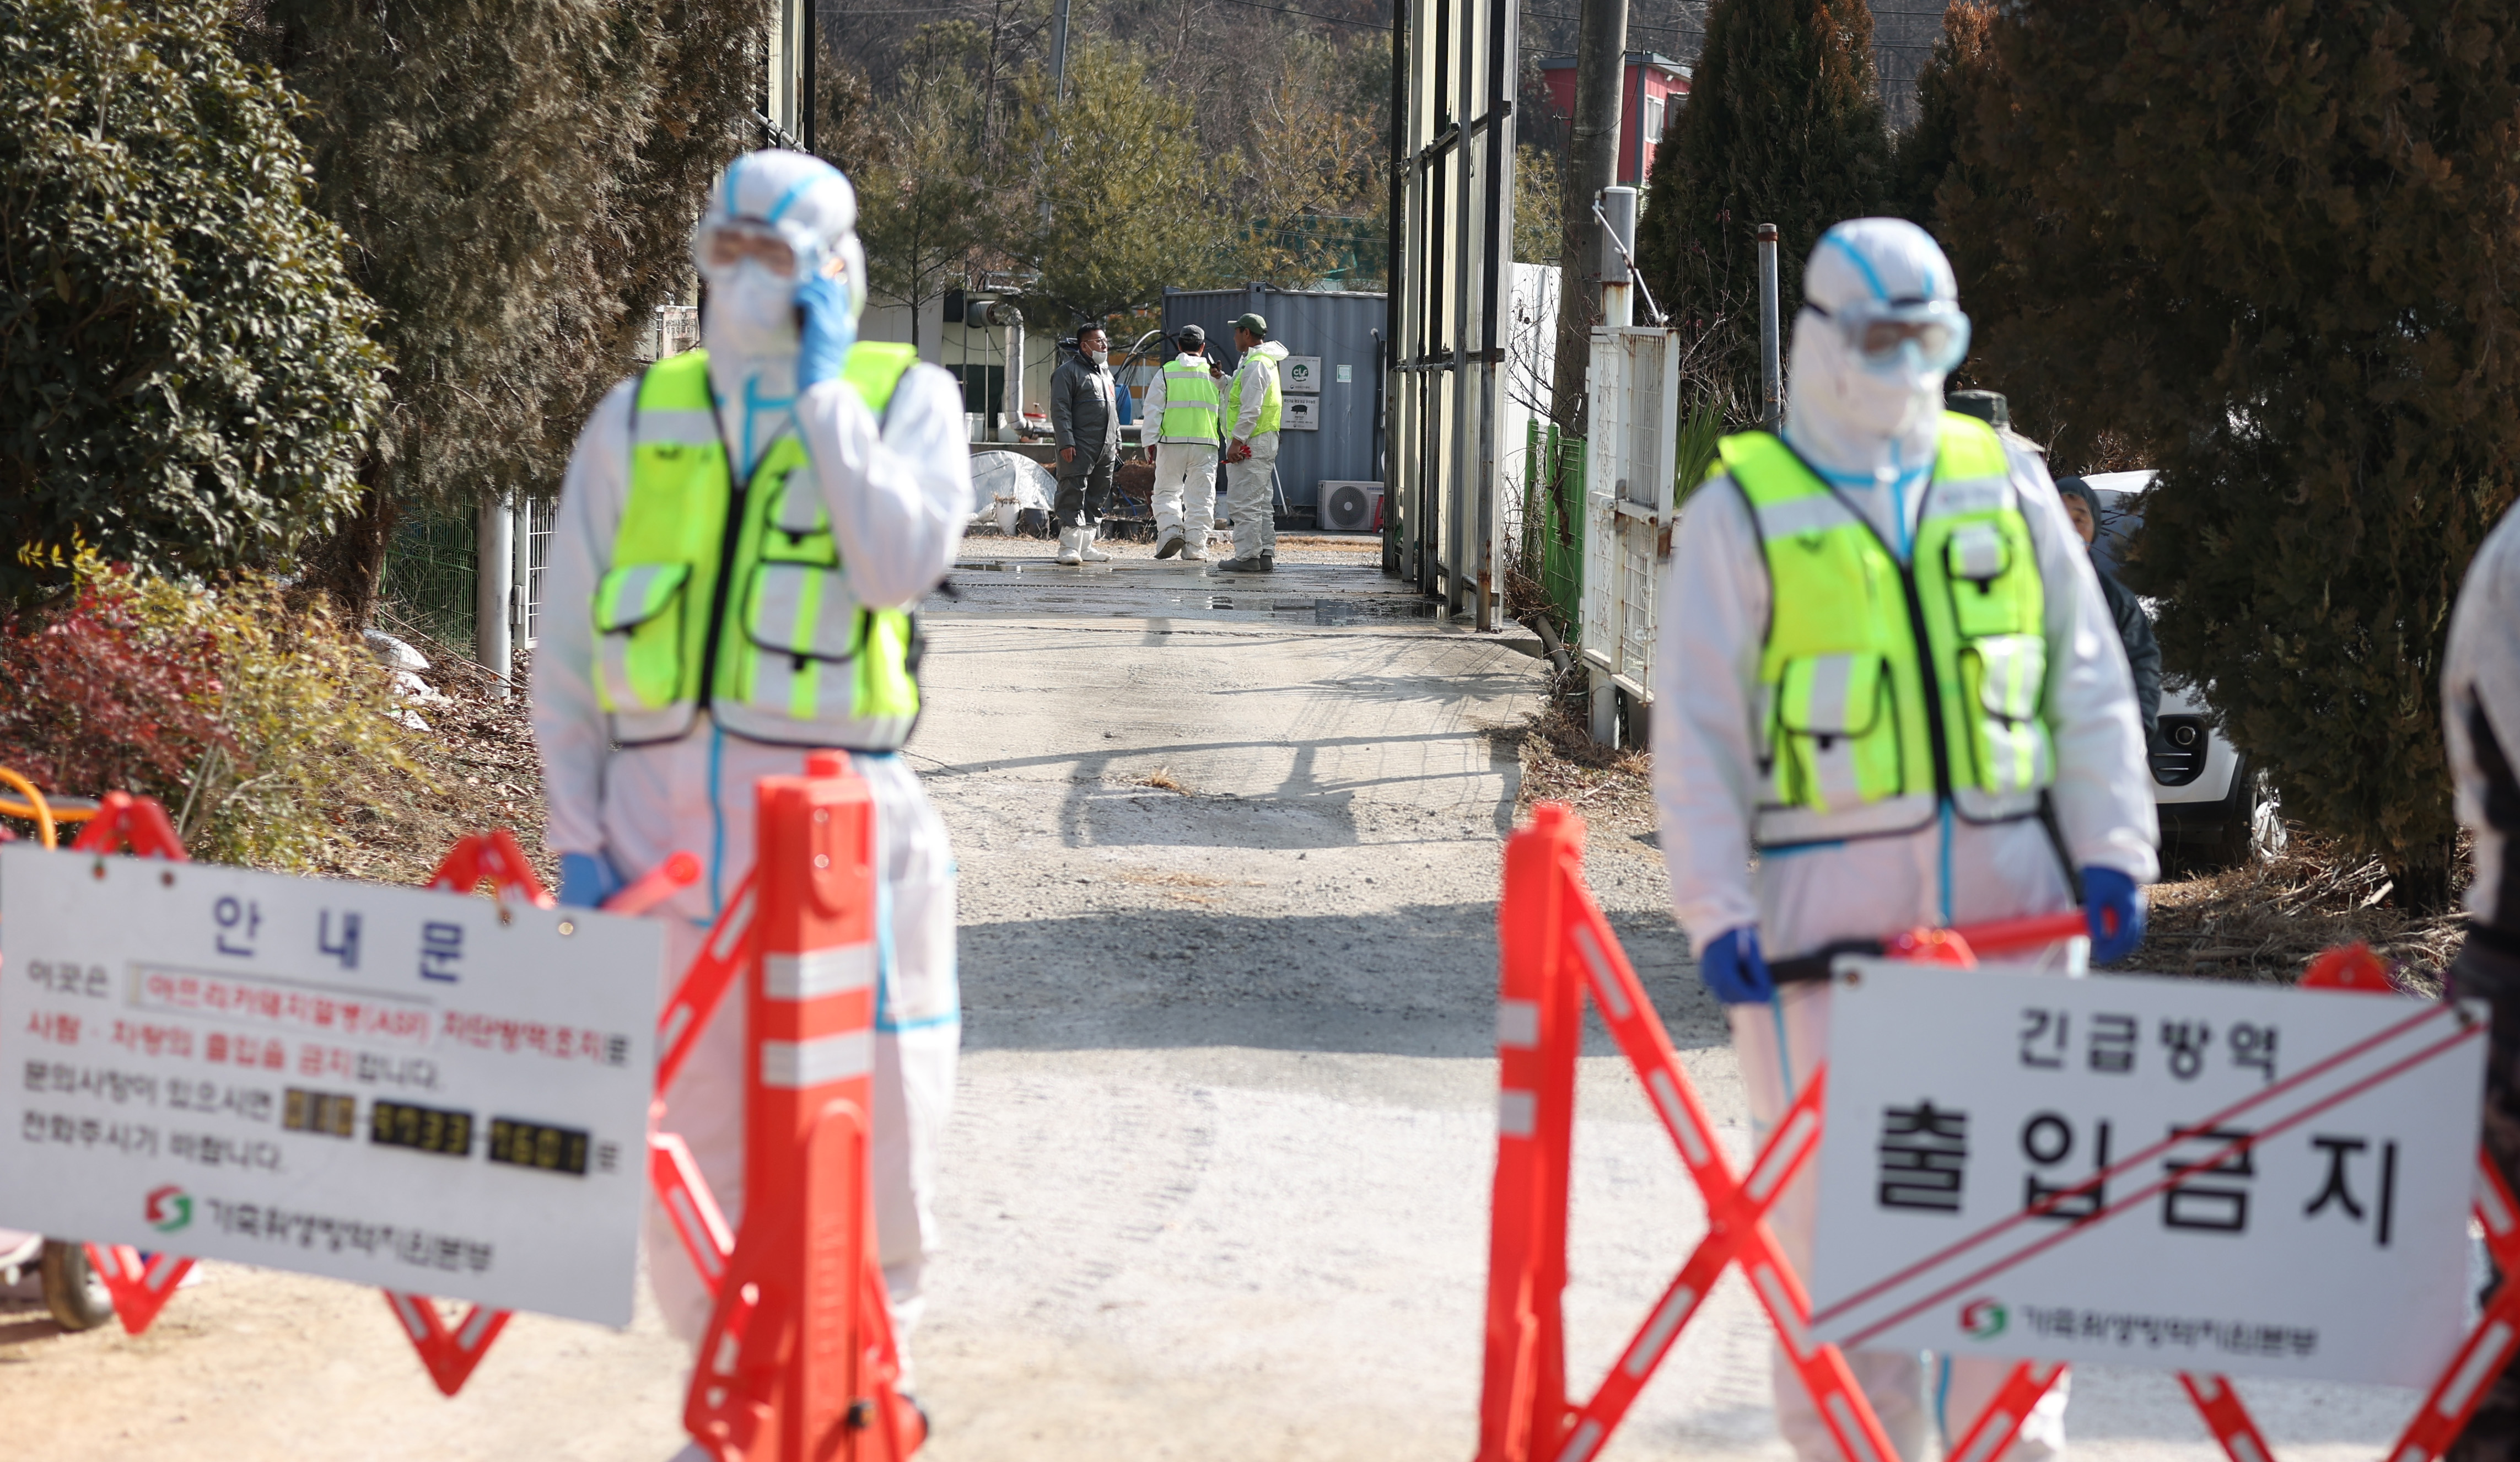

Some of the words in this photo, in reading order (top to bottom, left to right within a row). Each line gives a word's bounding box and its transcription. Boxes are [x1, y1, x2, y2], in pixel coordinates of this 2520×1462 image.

[27, 959, 109, 999] 이곳은
[146, 974, 431, 1046] 아프리카돼지열병(ASF)
[443, 1009, 630, 1069] 차단방역조치로
[27, 1011, 82, 1046] 사람
[112, 1018, 193, 1057] 차량의
[206, 1032, 286, 1071] 출입을
[2018, 1008, 2279, 1083] 긴급방역
[24, 1060, 159, 1105] 문의사항이
[167, 1077, 273, 1122] 있으시면
[21, 1110, 160, 1158] 전화주시기
[1876, 1098, 2401, 1248] 출입금지
[205, 1197, 496, 1275] 가축위생방역지원본부
[2020, 1304, 2319, 1358] 가축위생방역지원본부
